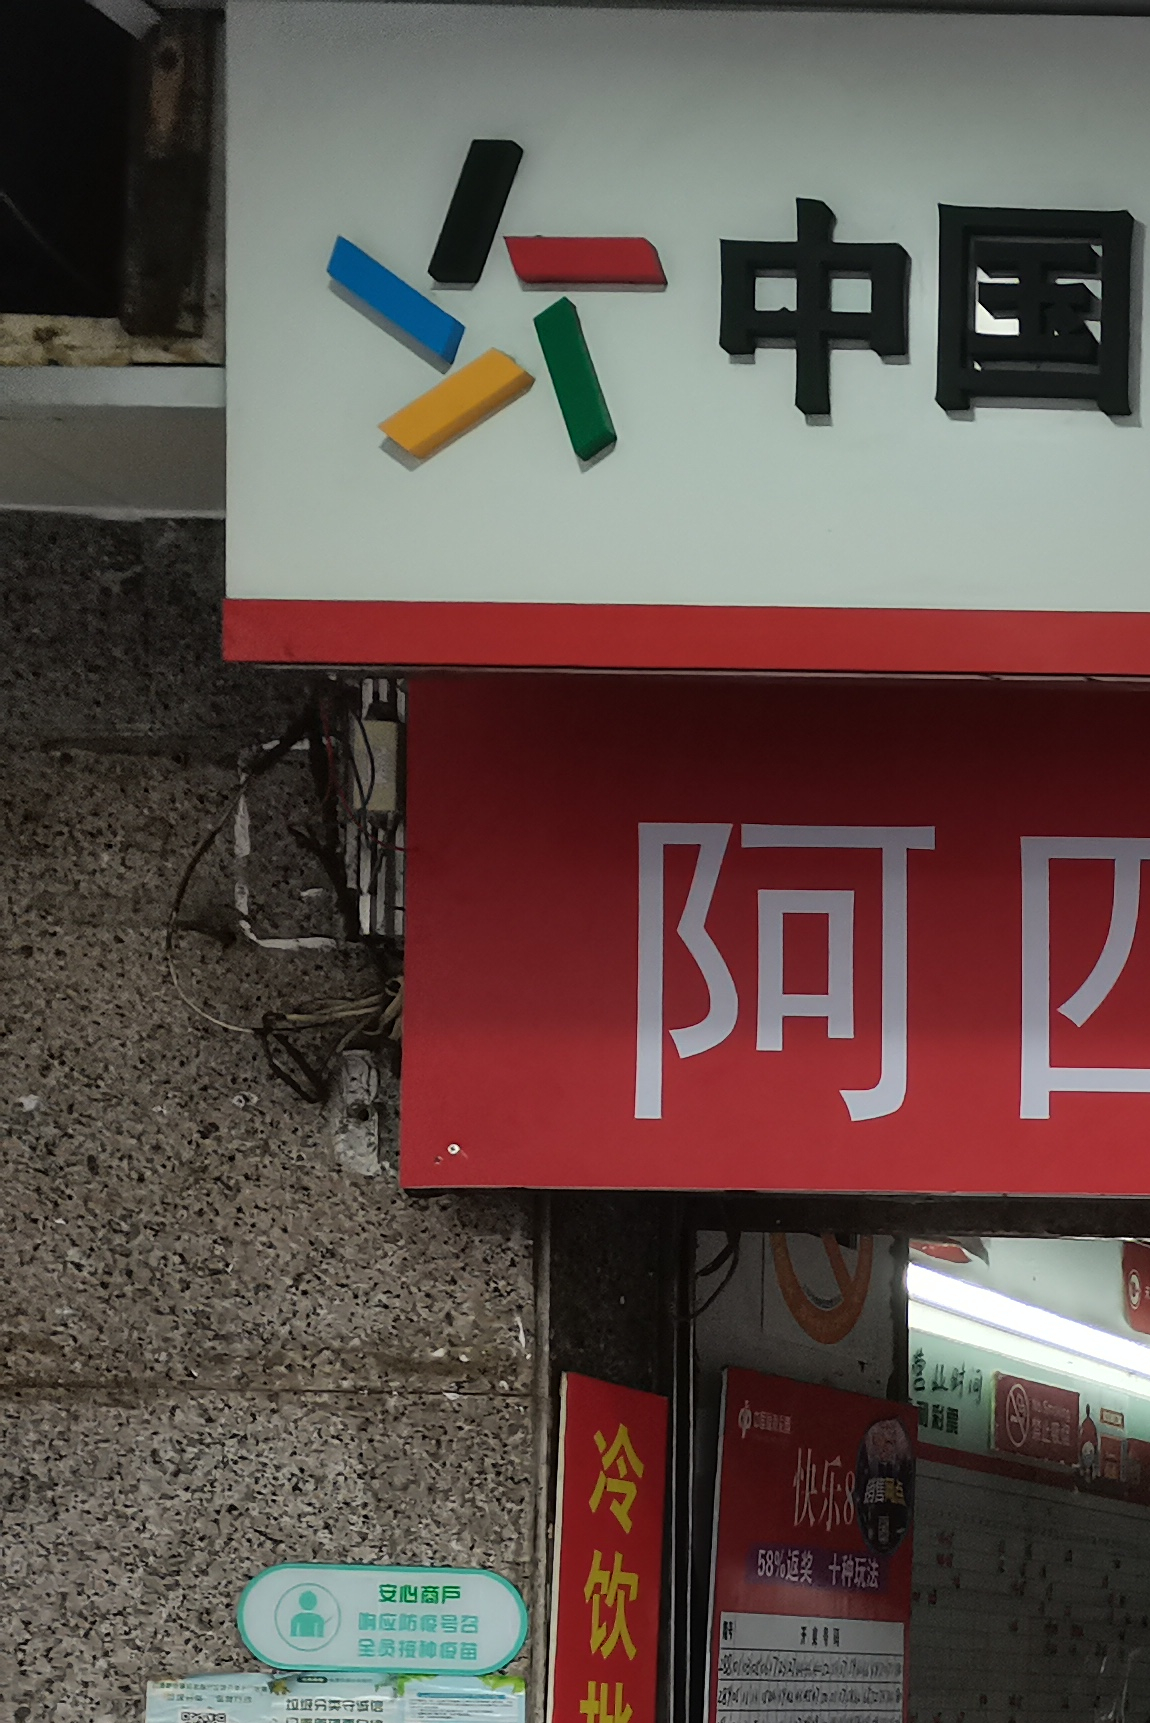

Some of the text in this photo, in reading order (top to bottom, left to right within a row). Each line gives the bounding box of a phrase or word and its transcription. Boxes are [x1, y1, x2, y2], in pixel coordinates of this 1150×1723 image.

[793, 1448, 855, 1532] 快乐8
[757, 1549, 879, 1589] 58%返奖 十种玩法
[378, 1584, 461, 1604] 安心商户
[358, 1612, 478, 1634] 响应防疫号召
[358, 1638, 478, 1660] 全员接种疫苗
